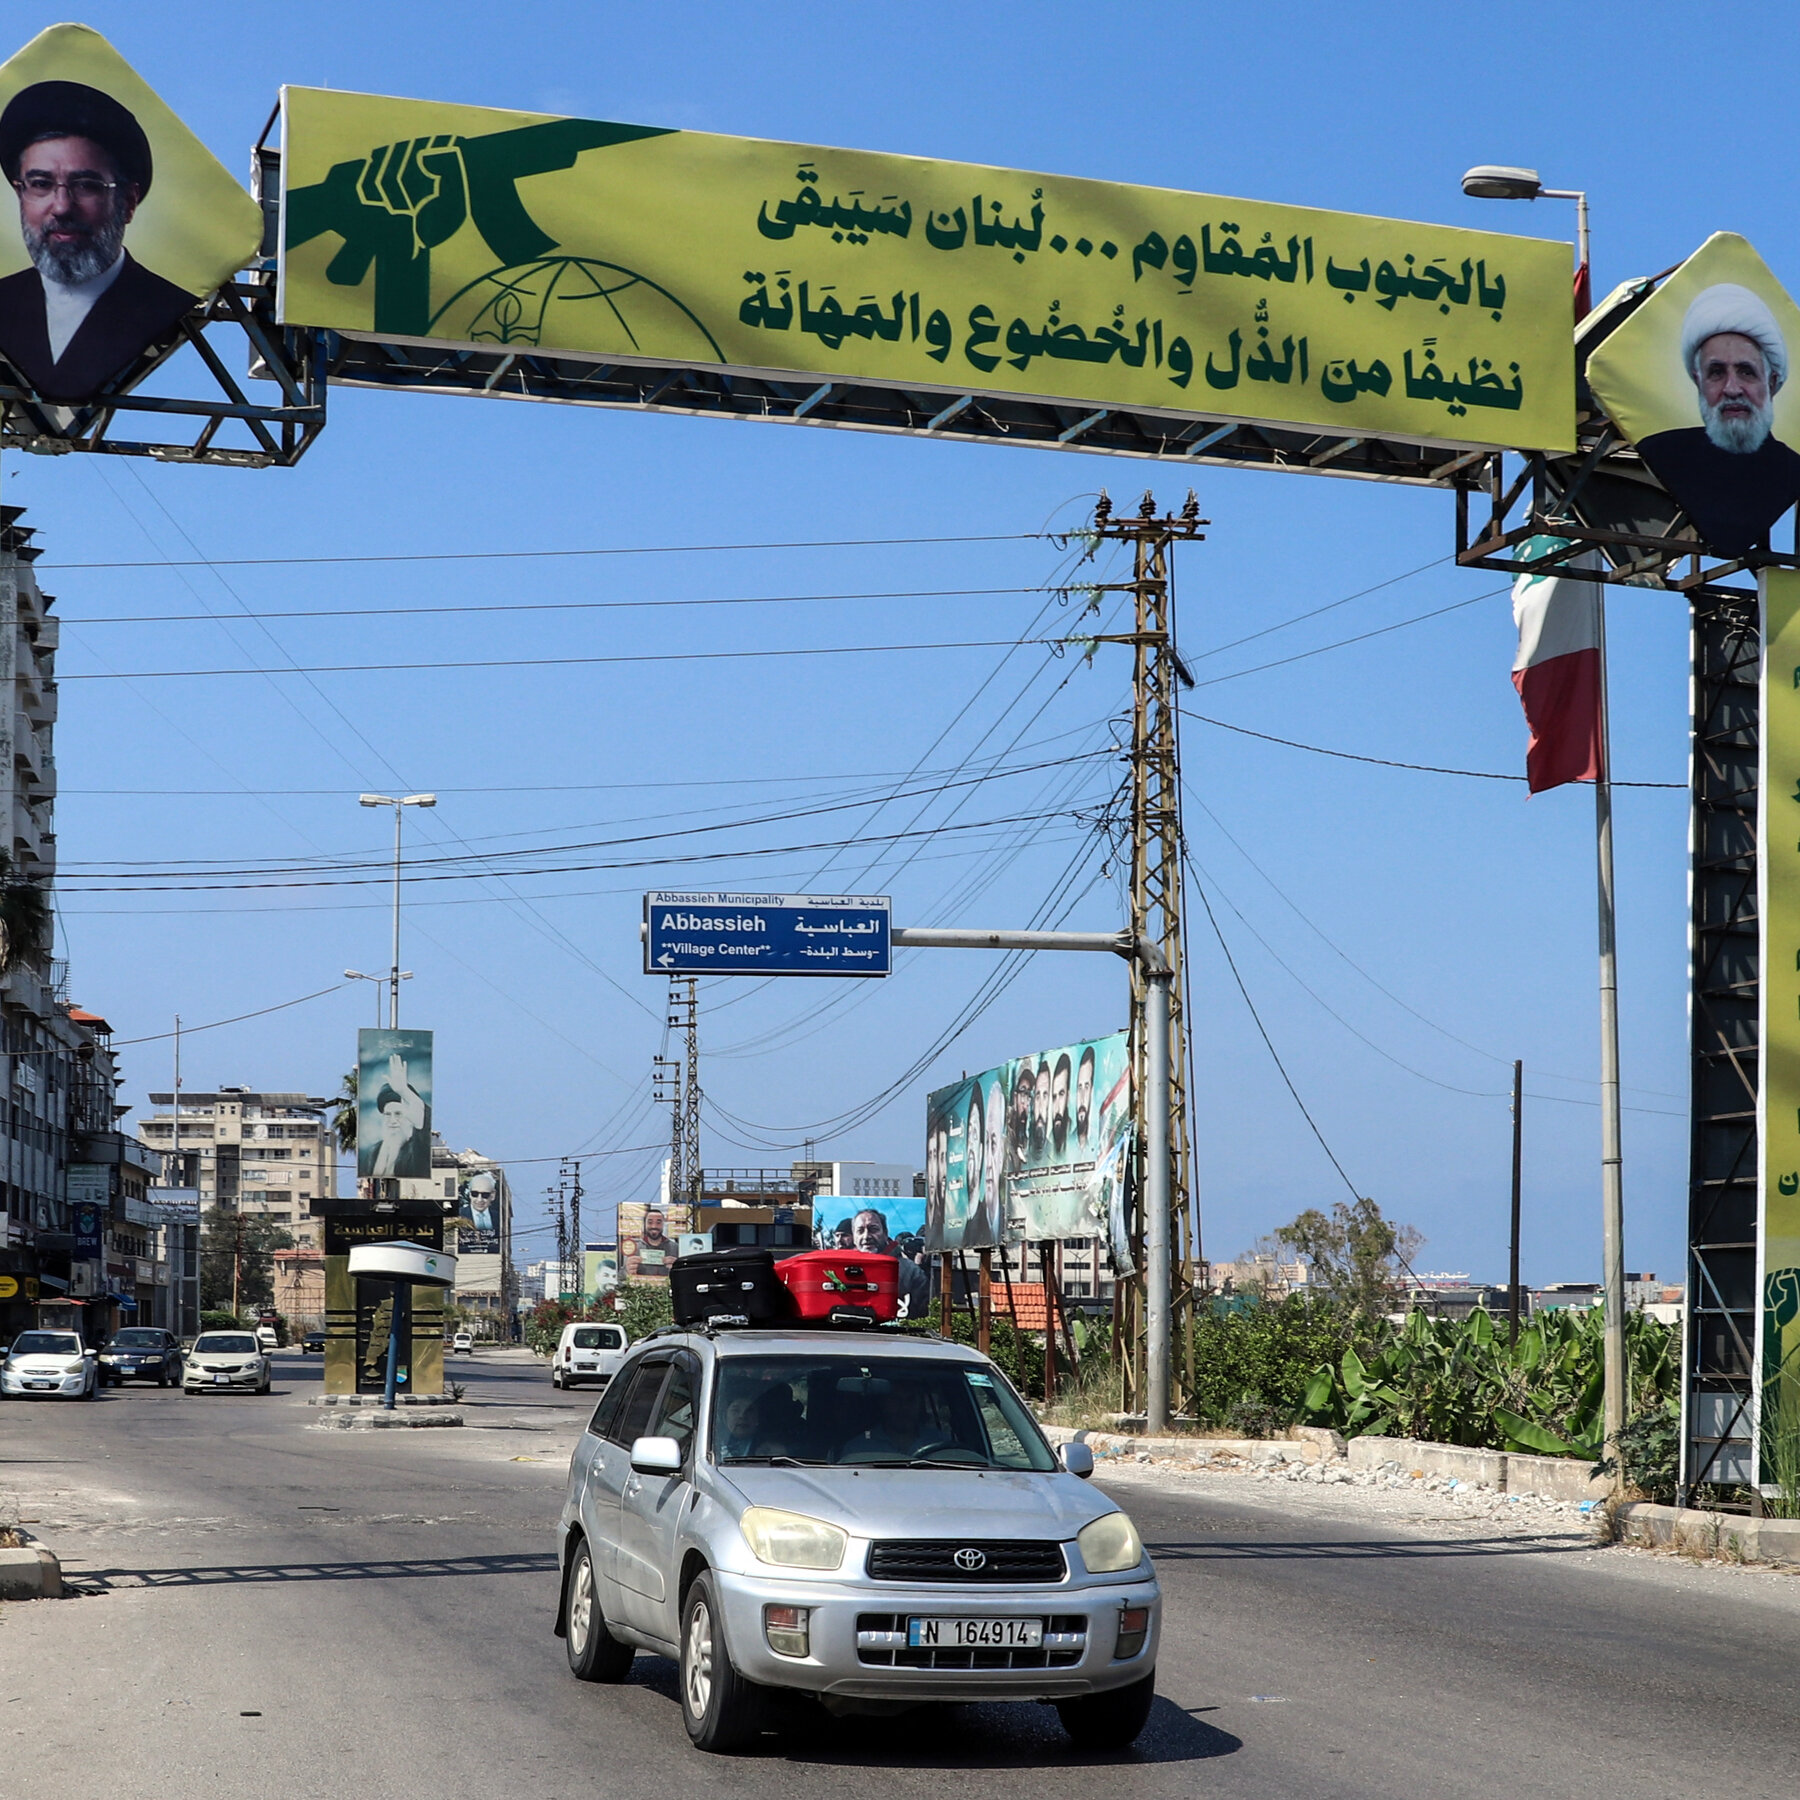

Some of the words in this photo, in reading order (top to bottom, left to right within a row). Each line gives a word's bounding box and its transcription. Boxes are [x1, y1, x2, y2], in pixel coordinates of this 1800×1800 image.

[656, 893, 714, 903] Abbassieh
[718, 894, 785, 906] Municipality
[808, 897, 853, 908] العباسية
[859, 898, 884, 908] بلدية
[661, 913, 766, 931] Abbassieh
[794, 916, 879, 938] العباسية
[334, 1223, 394, 1240] العباسية
[398, 1223, 435, 1240] بلدية
[926, 1621, 939, 1644] N
[955, 1621, 1028, 1644] 164914
